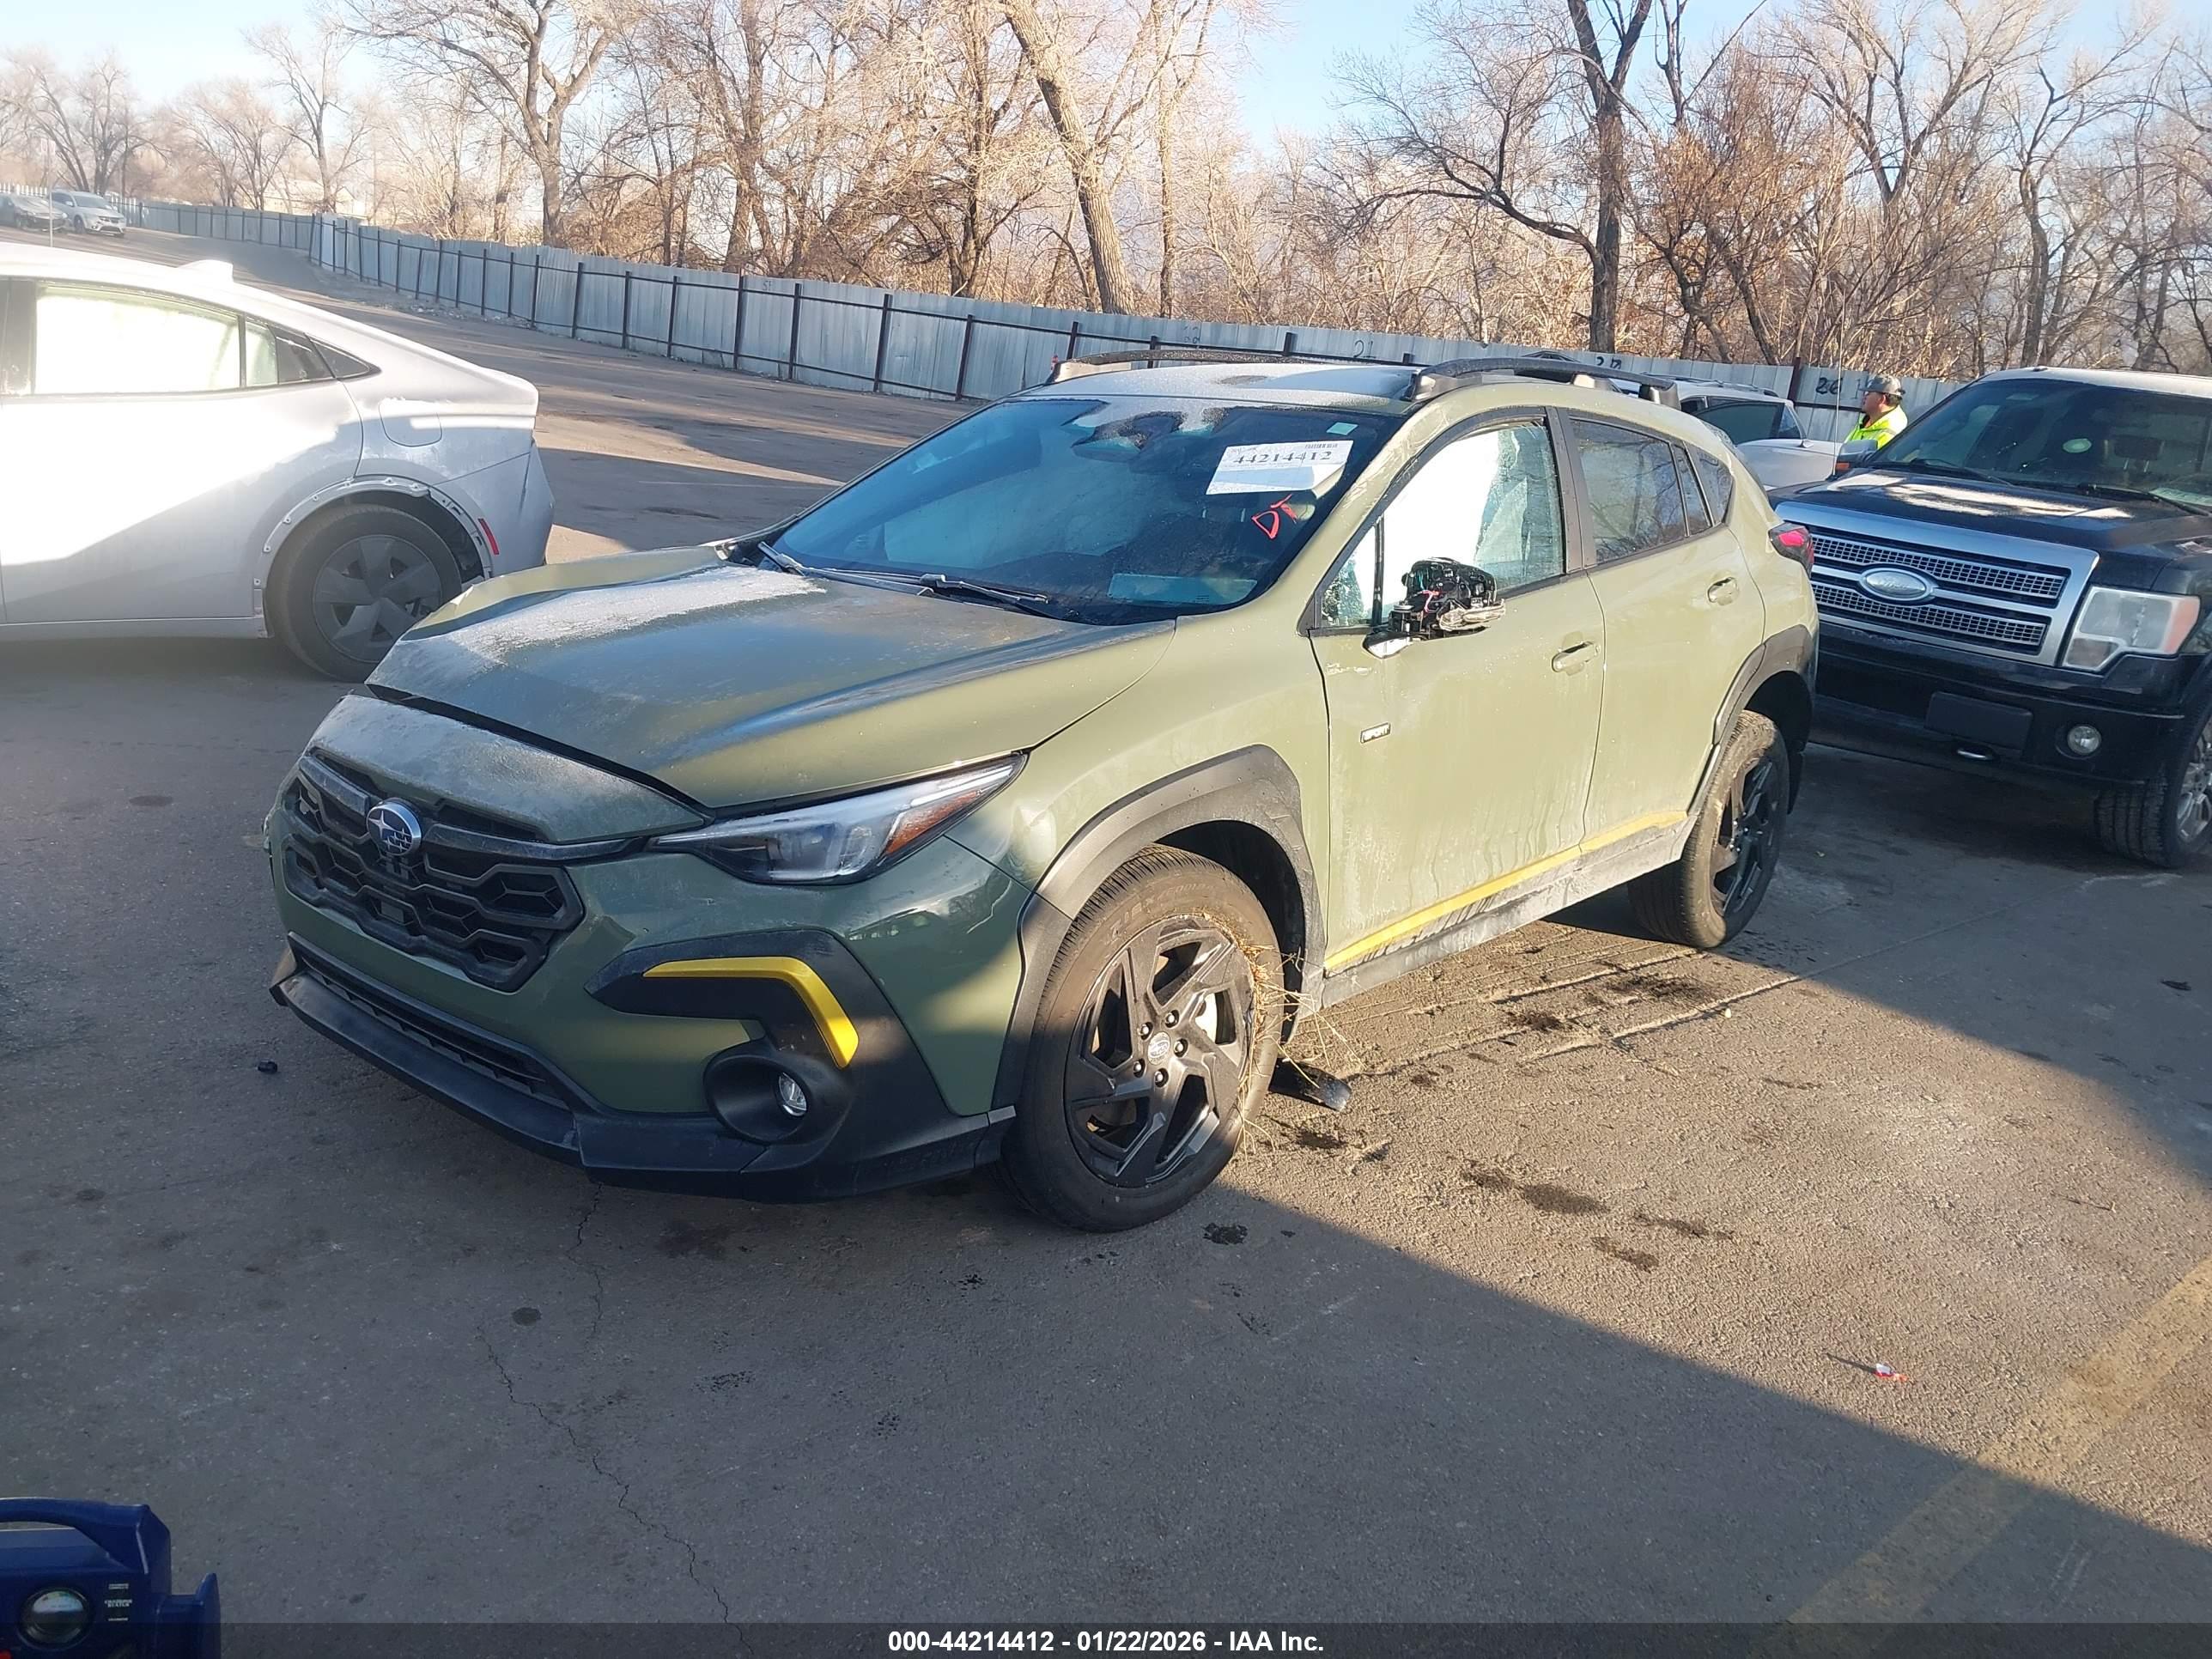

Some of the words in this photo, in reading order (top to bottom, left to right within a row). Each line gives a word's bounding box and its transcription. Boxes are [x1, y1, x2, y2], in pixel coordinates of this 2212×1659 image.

[1353, 339, 1376, 359] 21
[1815, 376, 1844, 395] 26
[1233, 451, 1332, 464] 44214412
